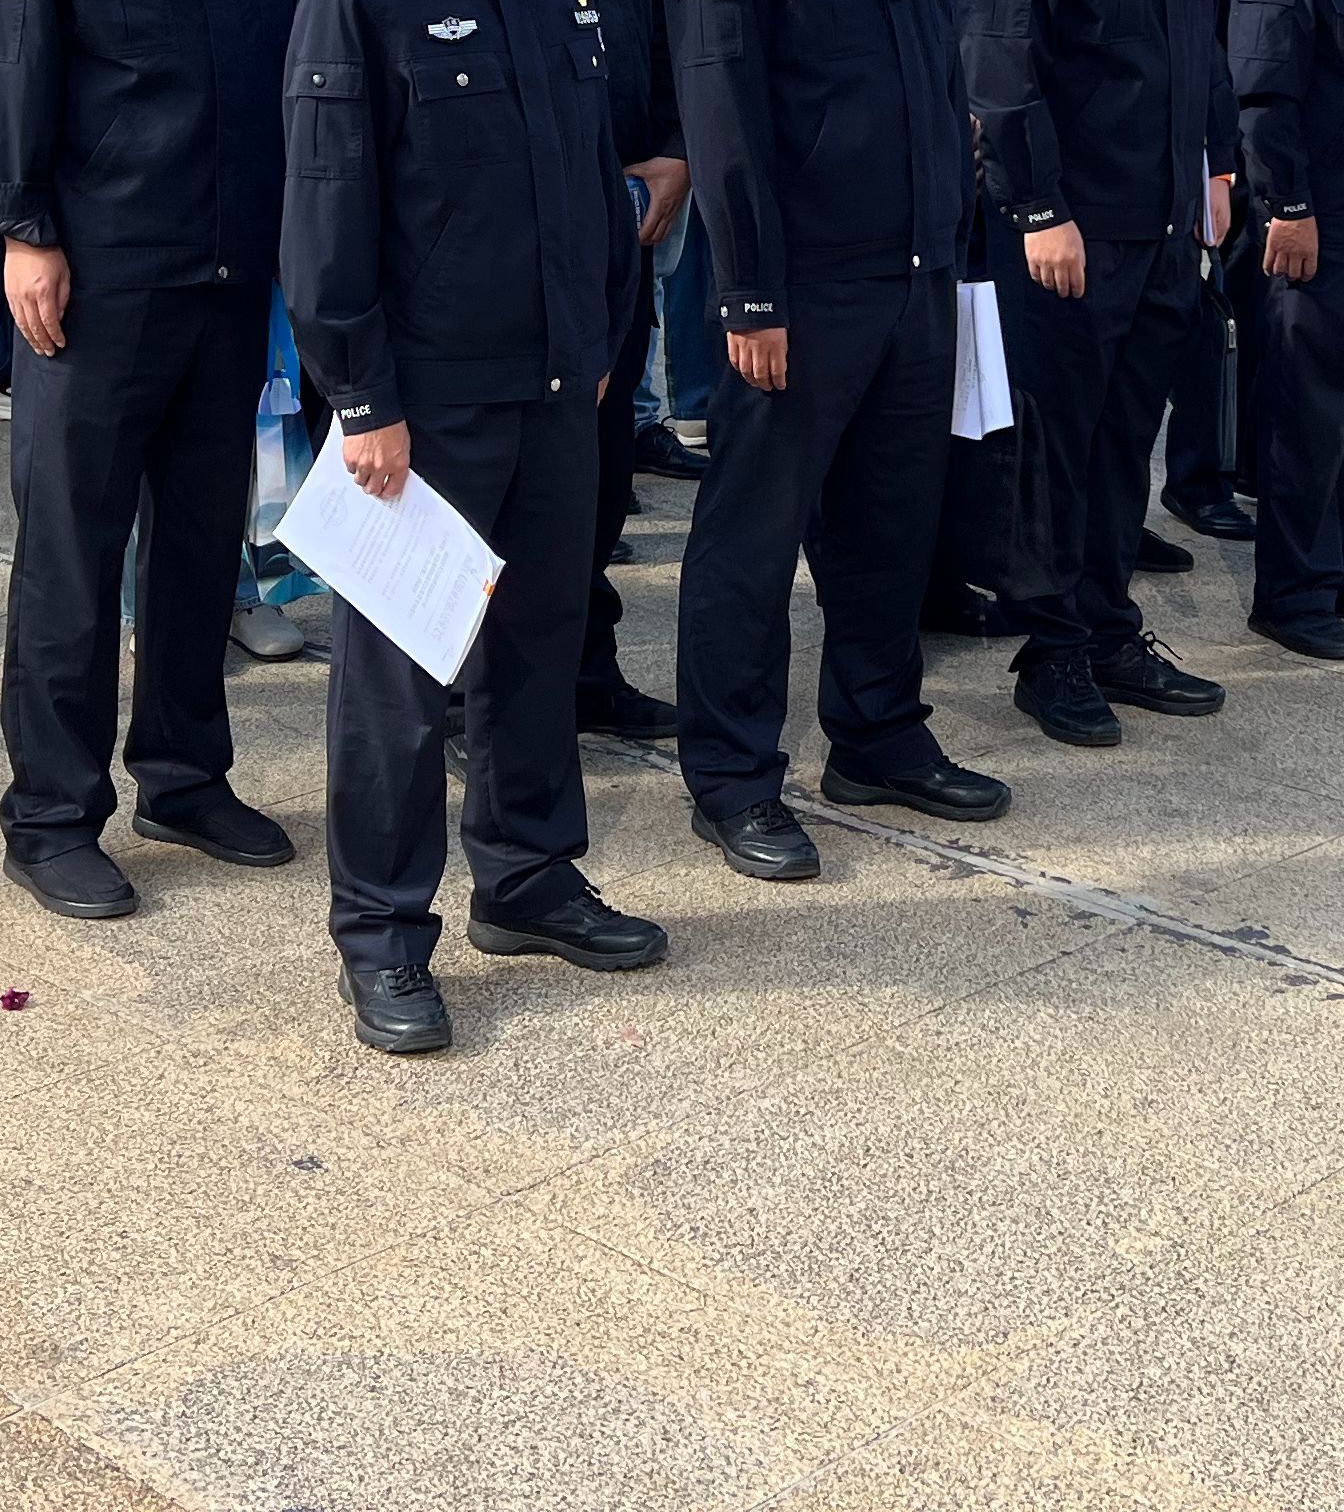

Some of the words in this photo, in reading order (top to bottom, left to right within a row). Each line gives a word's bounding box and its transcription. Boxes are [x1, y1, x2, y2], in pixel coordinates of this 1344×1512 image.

[1028, 209, 1054, 223] POLICE
[744, 302, 773, 313] POLICE
[340, 404, 372, 420] POLICE
